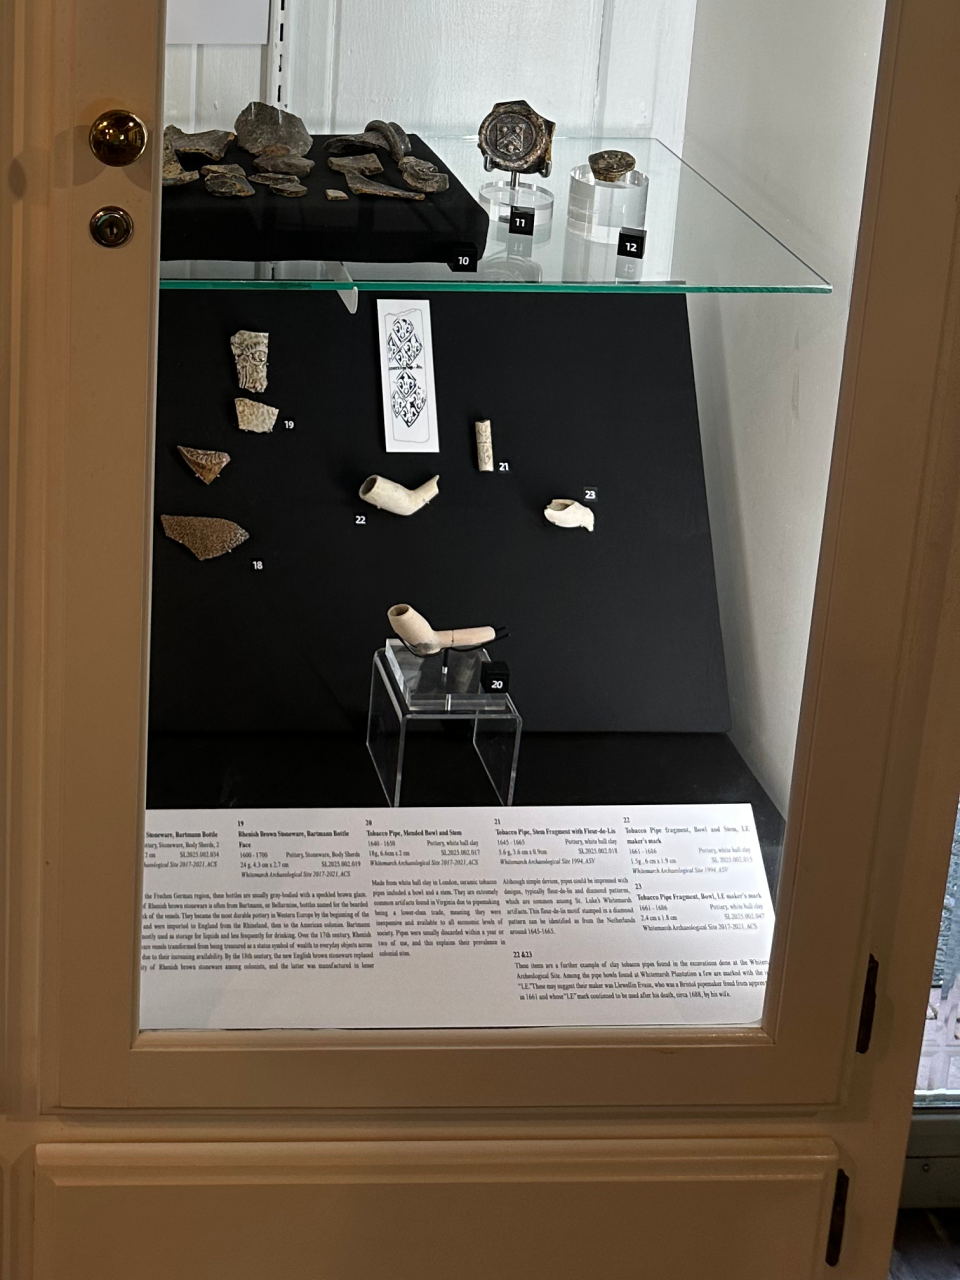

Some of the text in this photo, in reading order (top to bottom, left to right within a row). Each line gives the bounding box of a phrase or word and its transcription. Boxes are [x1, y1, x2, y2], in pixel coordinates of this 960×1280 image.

[515, 218, 526, 227] 11
[625, 242, 637, 252] 12
[458, 256, 470, 265] 10
[284, 420, 295, 429] 19
[498, 462, 509, 471] 21
[585, 490, 596, 500] 23
[355, 515, 366, 525] 22
[252, 560, 263, 570] 18
[491, 680, 504, 689] 20
[545, 828, 571, 836] Fragment
[625, 826, 647, 834] Tobacco
[649, 826, 662, 835] Pipe
[636, 893, 659, 901] Tobacco
